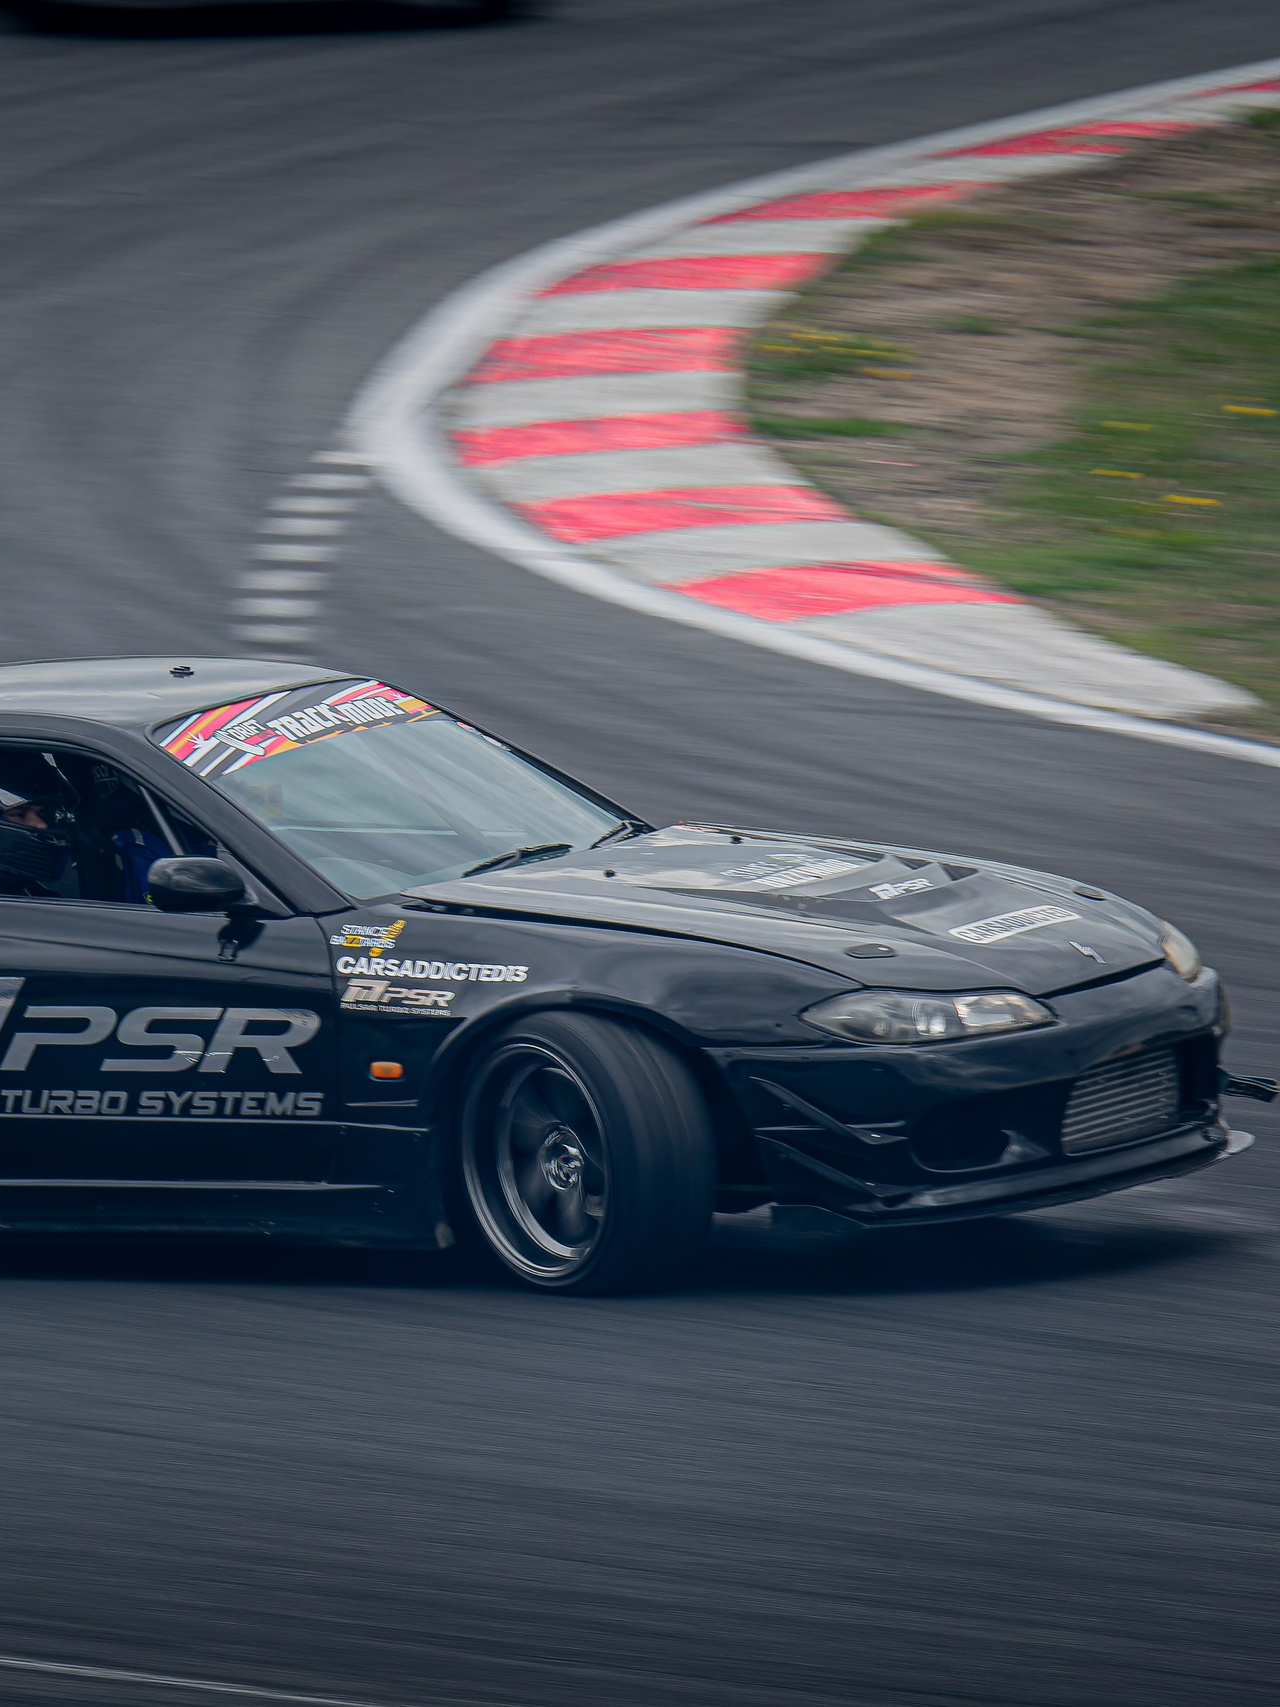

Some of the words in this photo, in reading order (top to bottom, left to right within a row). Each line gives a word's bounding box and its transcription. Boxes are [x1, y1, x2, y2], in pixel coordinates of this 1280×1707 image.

[957, 907, 1075, 941] CARSADDICTED
[381, 987, 456, 1007] PSR
[0, 1005, 322, 1074] PSR
[0, 1089, 128, 1115] TURBO
[138, 1090, 324, 1117] SYSTEMS
